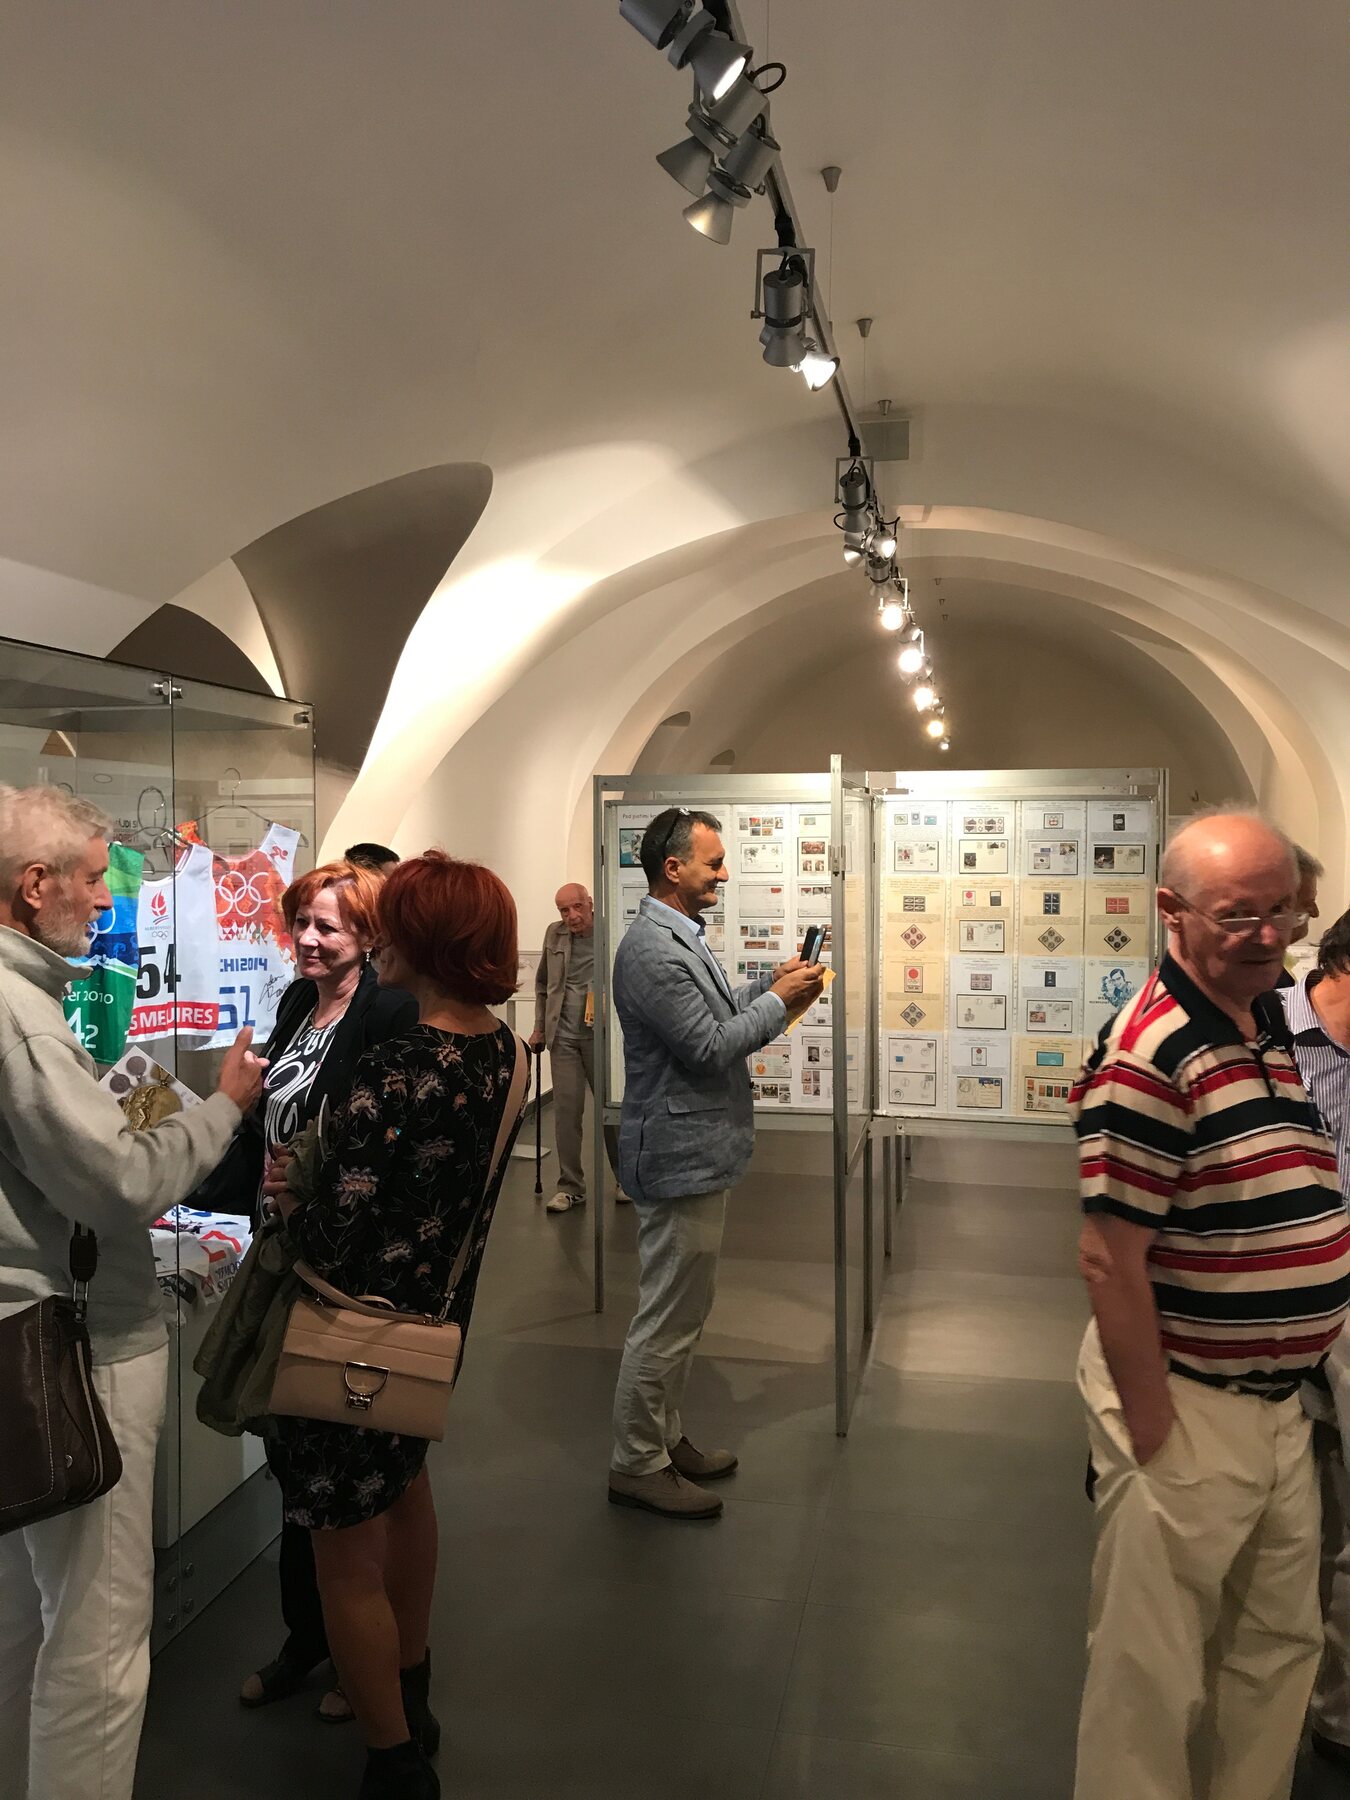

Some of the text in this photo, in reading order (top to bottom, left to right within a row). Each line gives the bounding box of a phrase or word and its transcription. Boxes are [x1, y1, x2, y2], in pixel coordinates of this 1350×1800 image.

[136, 943, 181, 999] 54
[83, 990, 114, 1004] 2010
[67, 1007, 99, 1049] 42
